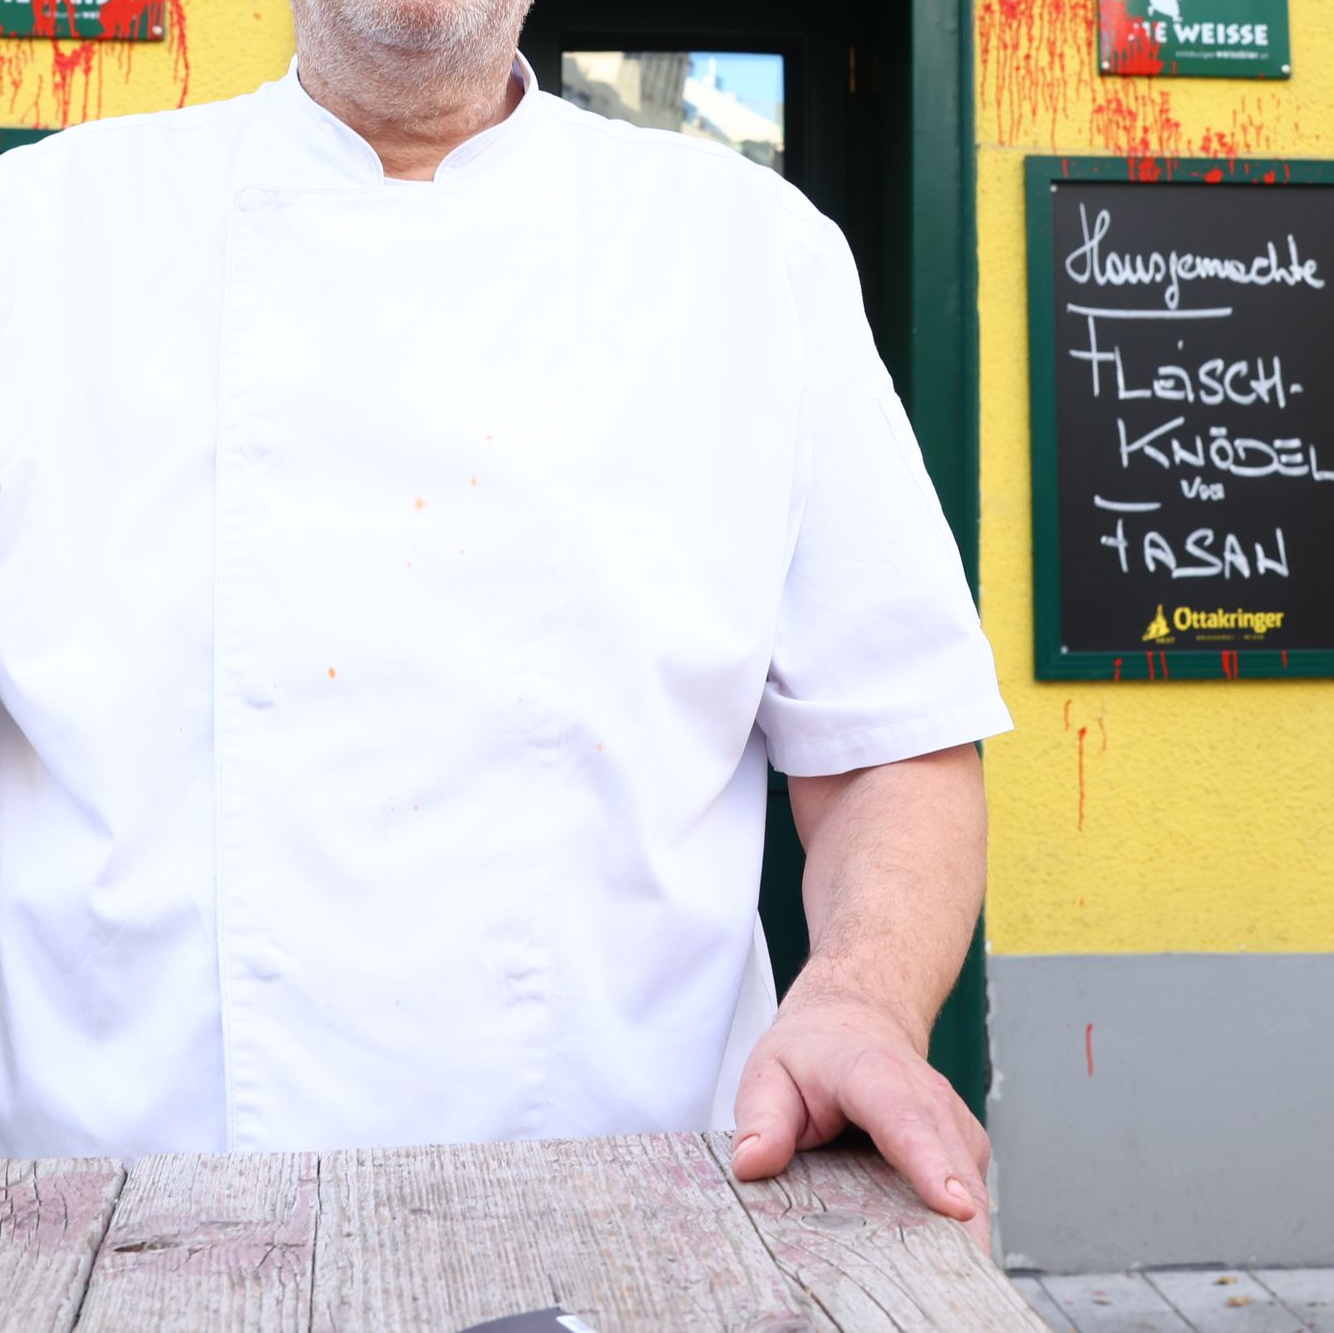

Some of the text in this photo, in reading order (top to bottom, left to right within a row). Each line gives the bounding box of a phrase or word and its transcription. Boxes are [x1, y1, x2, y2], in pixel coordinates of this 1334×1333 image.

[1172, 22, 1269, 46] WEISSE
[1066, 202, 1325, 310] Hausgemachte
[1172, 606, 1285, 634] Ottakringer
